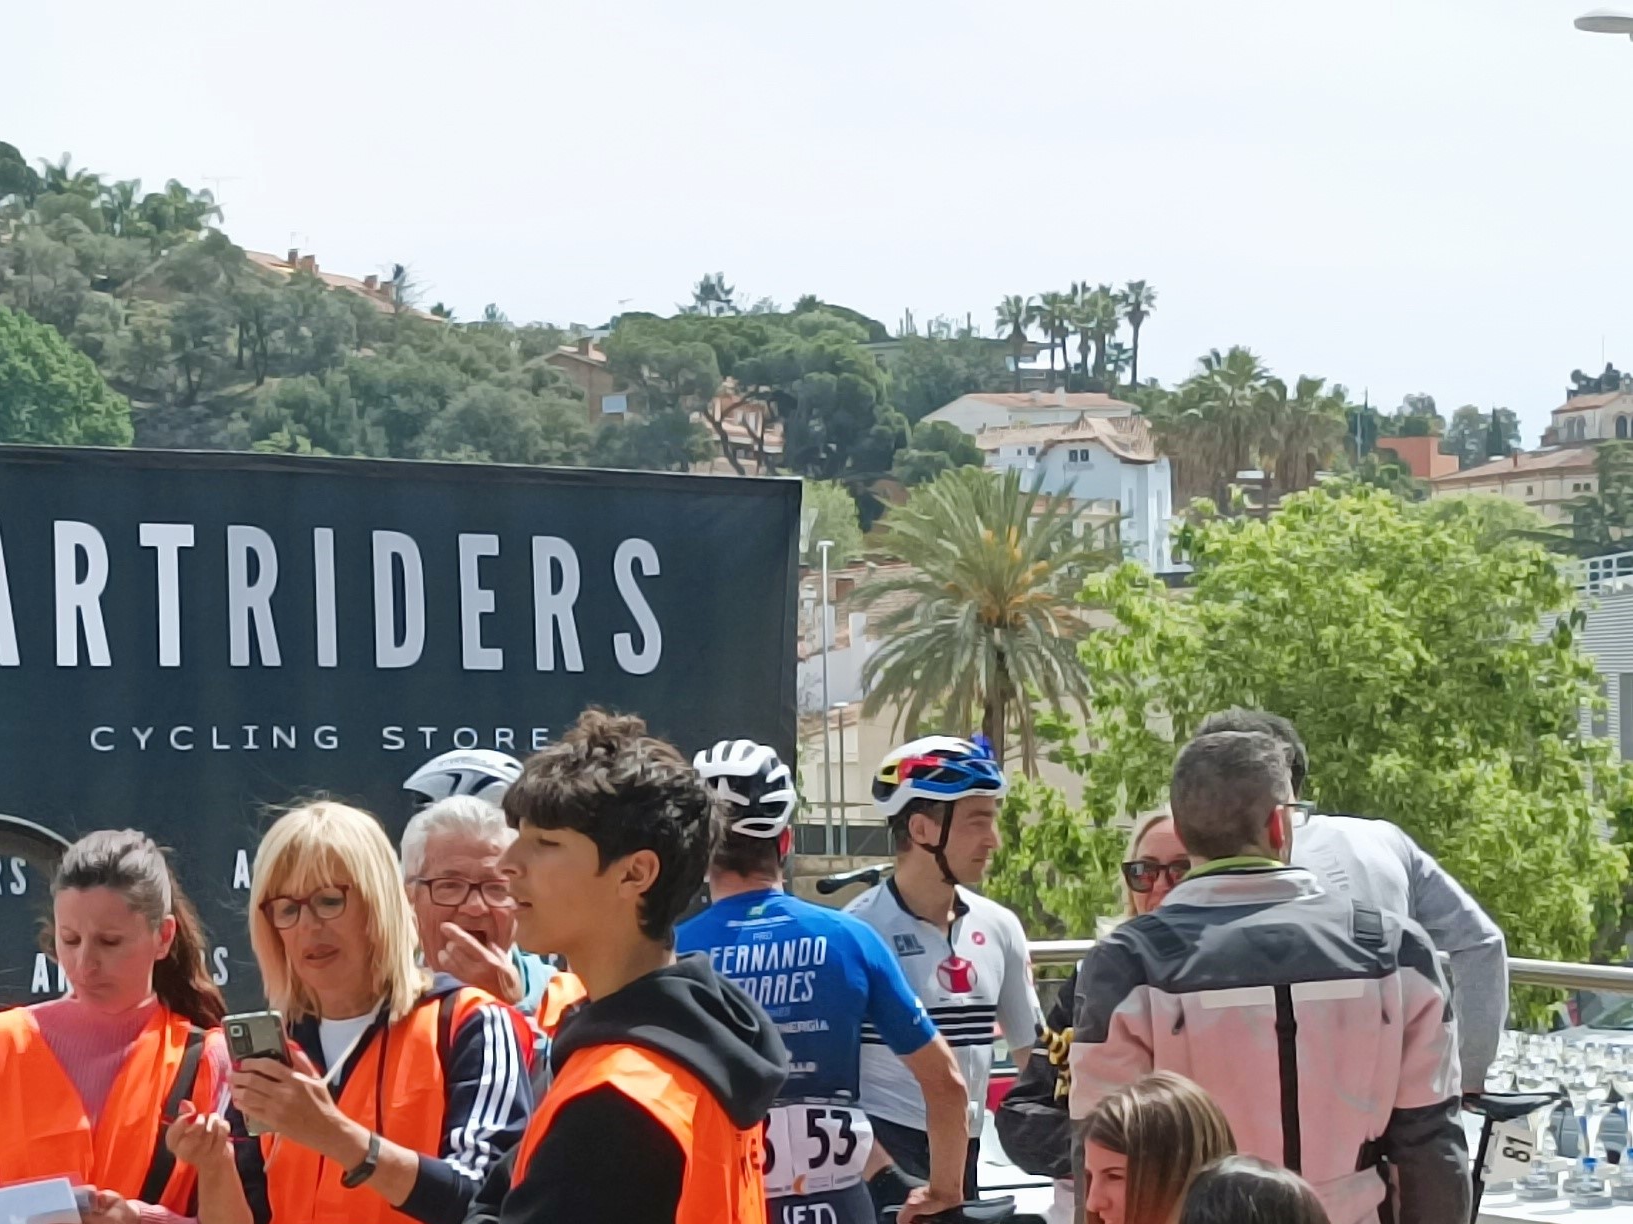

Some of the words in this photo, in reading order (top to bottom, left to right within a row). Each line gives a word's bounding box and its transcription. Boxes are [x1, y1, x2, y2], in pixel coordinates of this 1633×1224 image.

[88, 724, 340, 753] CYCLING
[381, 726, 551, 752] STORE
[806, 1108, 857, 1170] 53
[1502, 1135, 1534, 1163] 81
